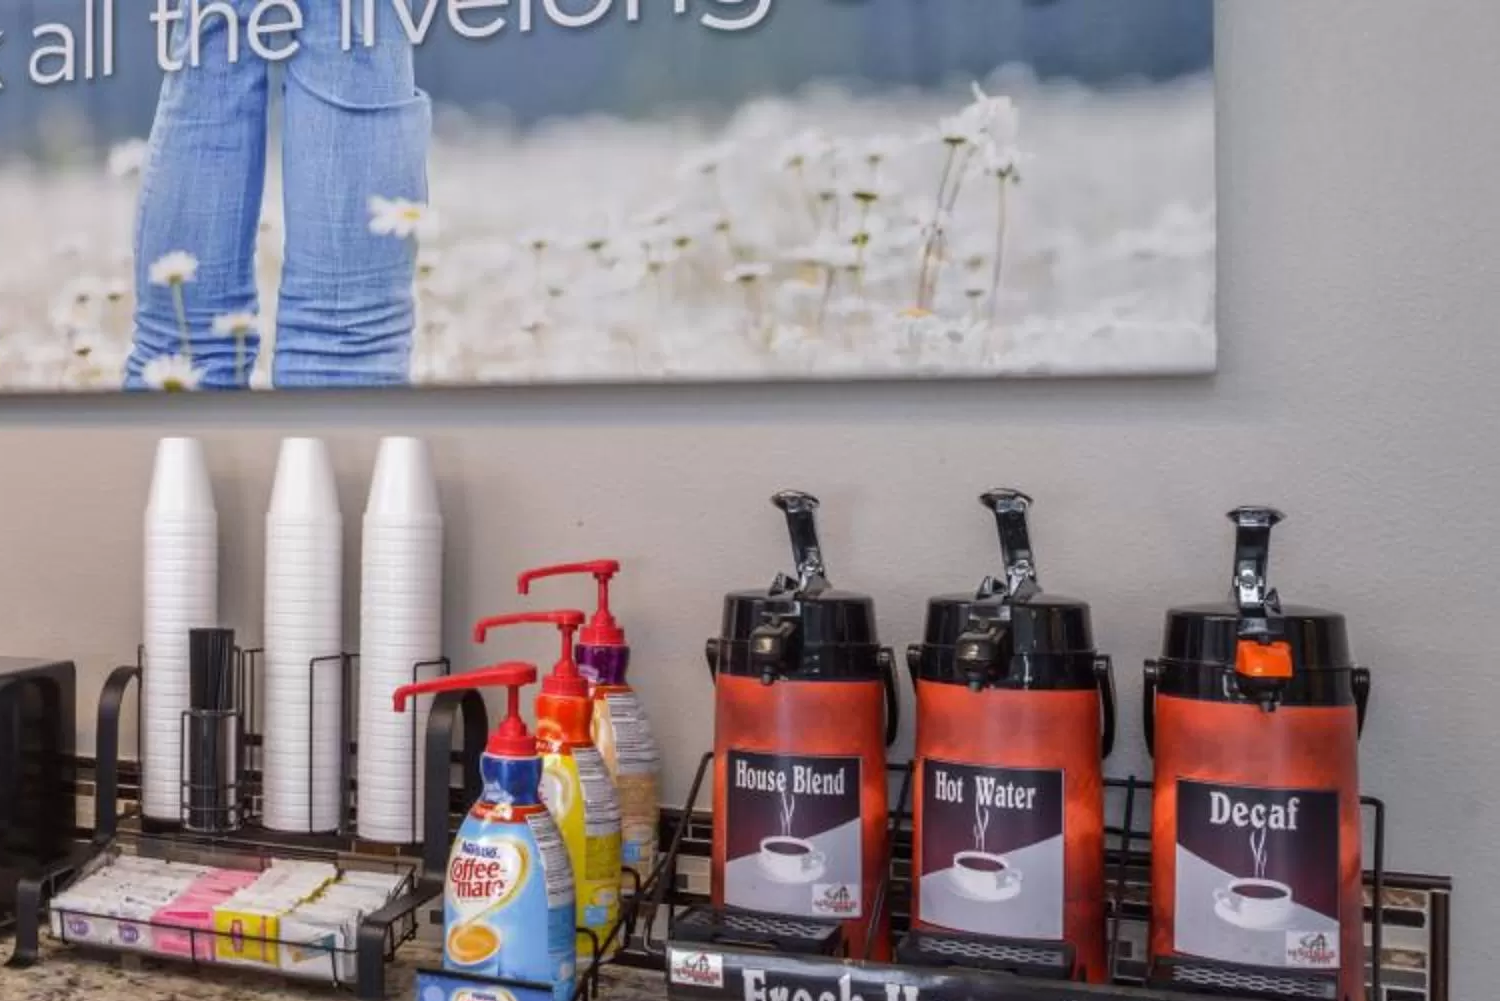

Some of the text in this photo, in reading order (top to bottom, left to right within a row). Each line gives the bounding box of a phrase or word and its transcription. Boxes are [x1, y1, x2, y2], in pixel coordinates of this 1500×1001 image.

[28, 0, 114, 84] all
[149, 0, 303, 72] the
[340, 0, 772, 52] live
[734, 758, 846, 796] House Blend
[935, 769, 1037, 811] Hot Water
[1209, 791, 1301, 831] Decaf
